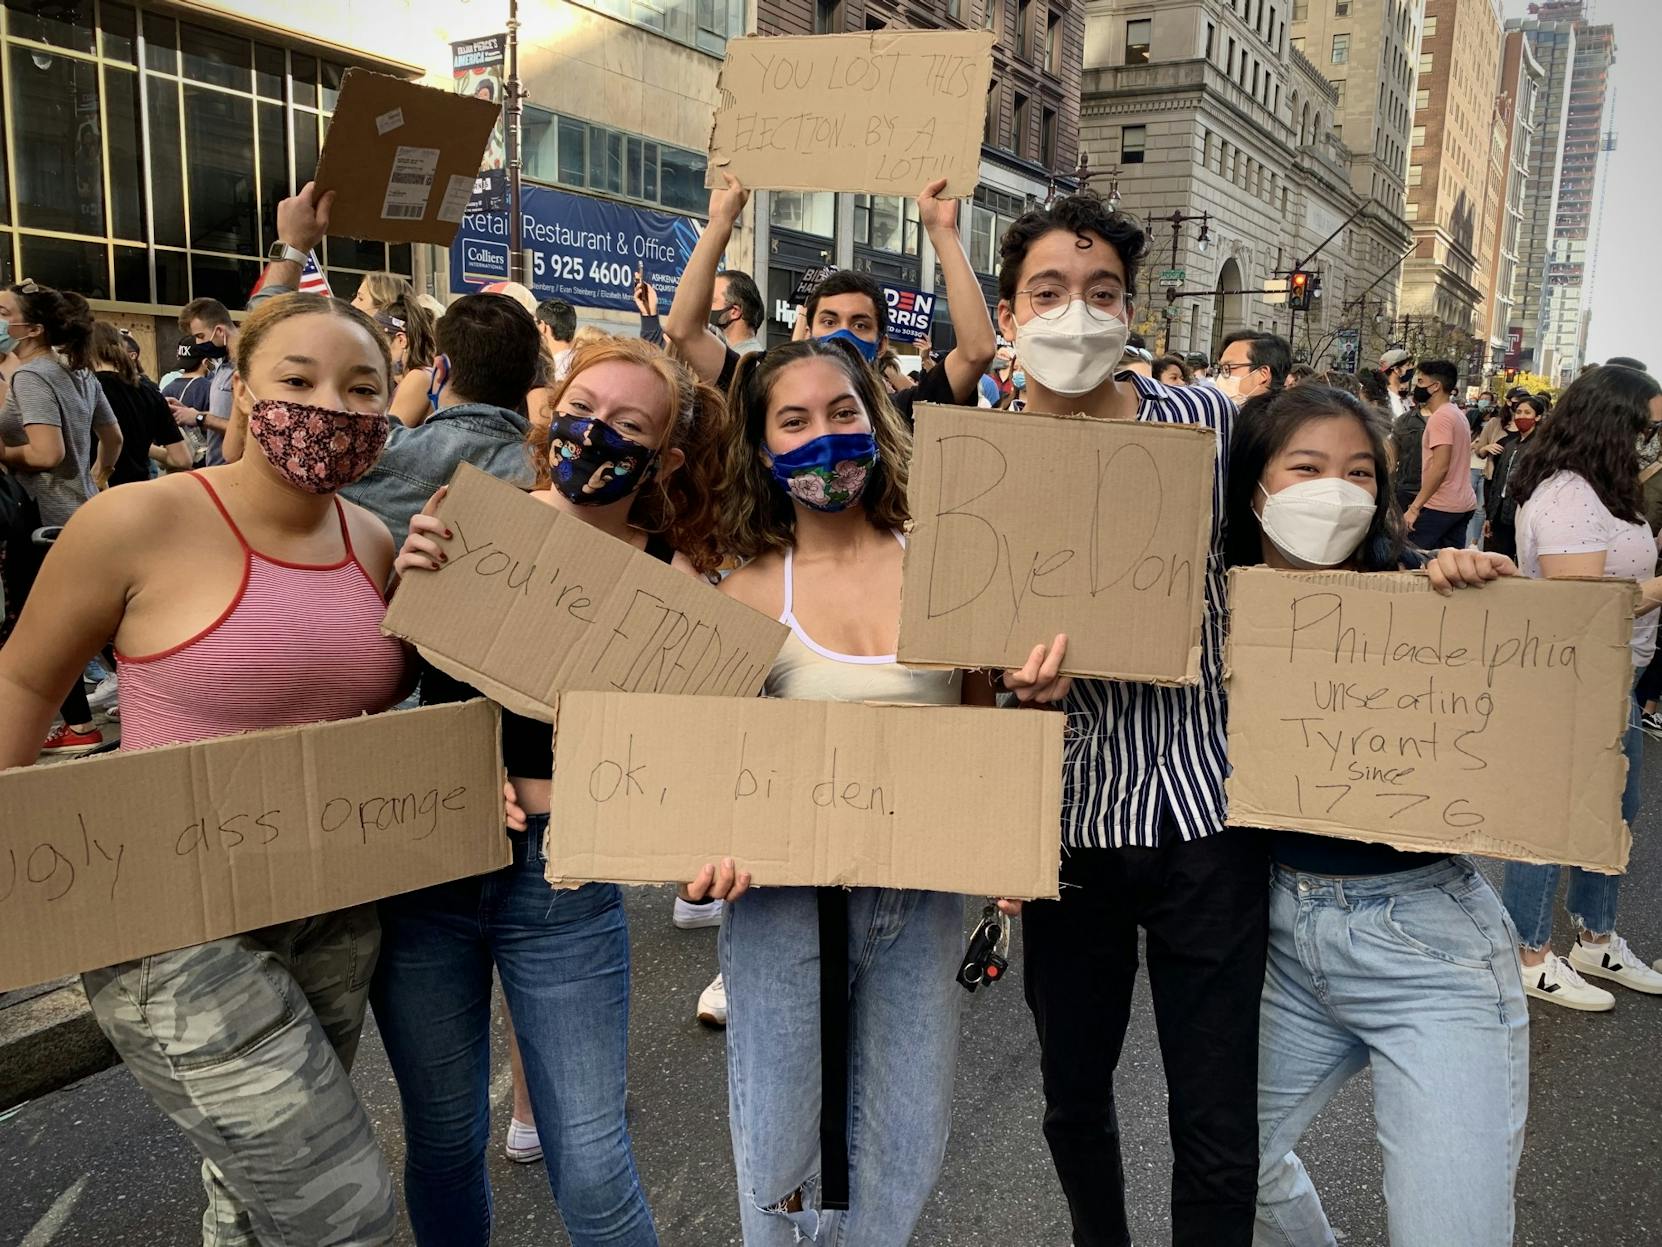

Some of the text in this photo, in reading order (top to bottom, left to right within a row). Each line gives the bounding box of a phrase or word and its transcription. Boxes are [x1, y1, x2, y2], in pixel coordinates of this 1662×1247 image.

[751, 51, 977, 98] YOU LOST THIS
[864, 114, 899, 147] BY
[904, 116, 937, 152] A
[467, 247, 505, 265] Colliers
[523, 214, 612, 252] Restaurant
[616, 232, 629, 255] &
[633, 235, 675, 263] Office
[551, 254, 585, 281] 925
[589, 260, 632, 288] 4600
[559, 285, 573, 294] Evan
[1289, 592, 1583, 688] Philadelphia
[1295, 775, 1485, 828] 1776
[175, 809, 281, 856] ass
